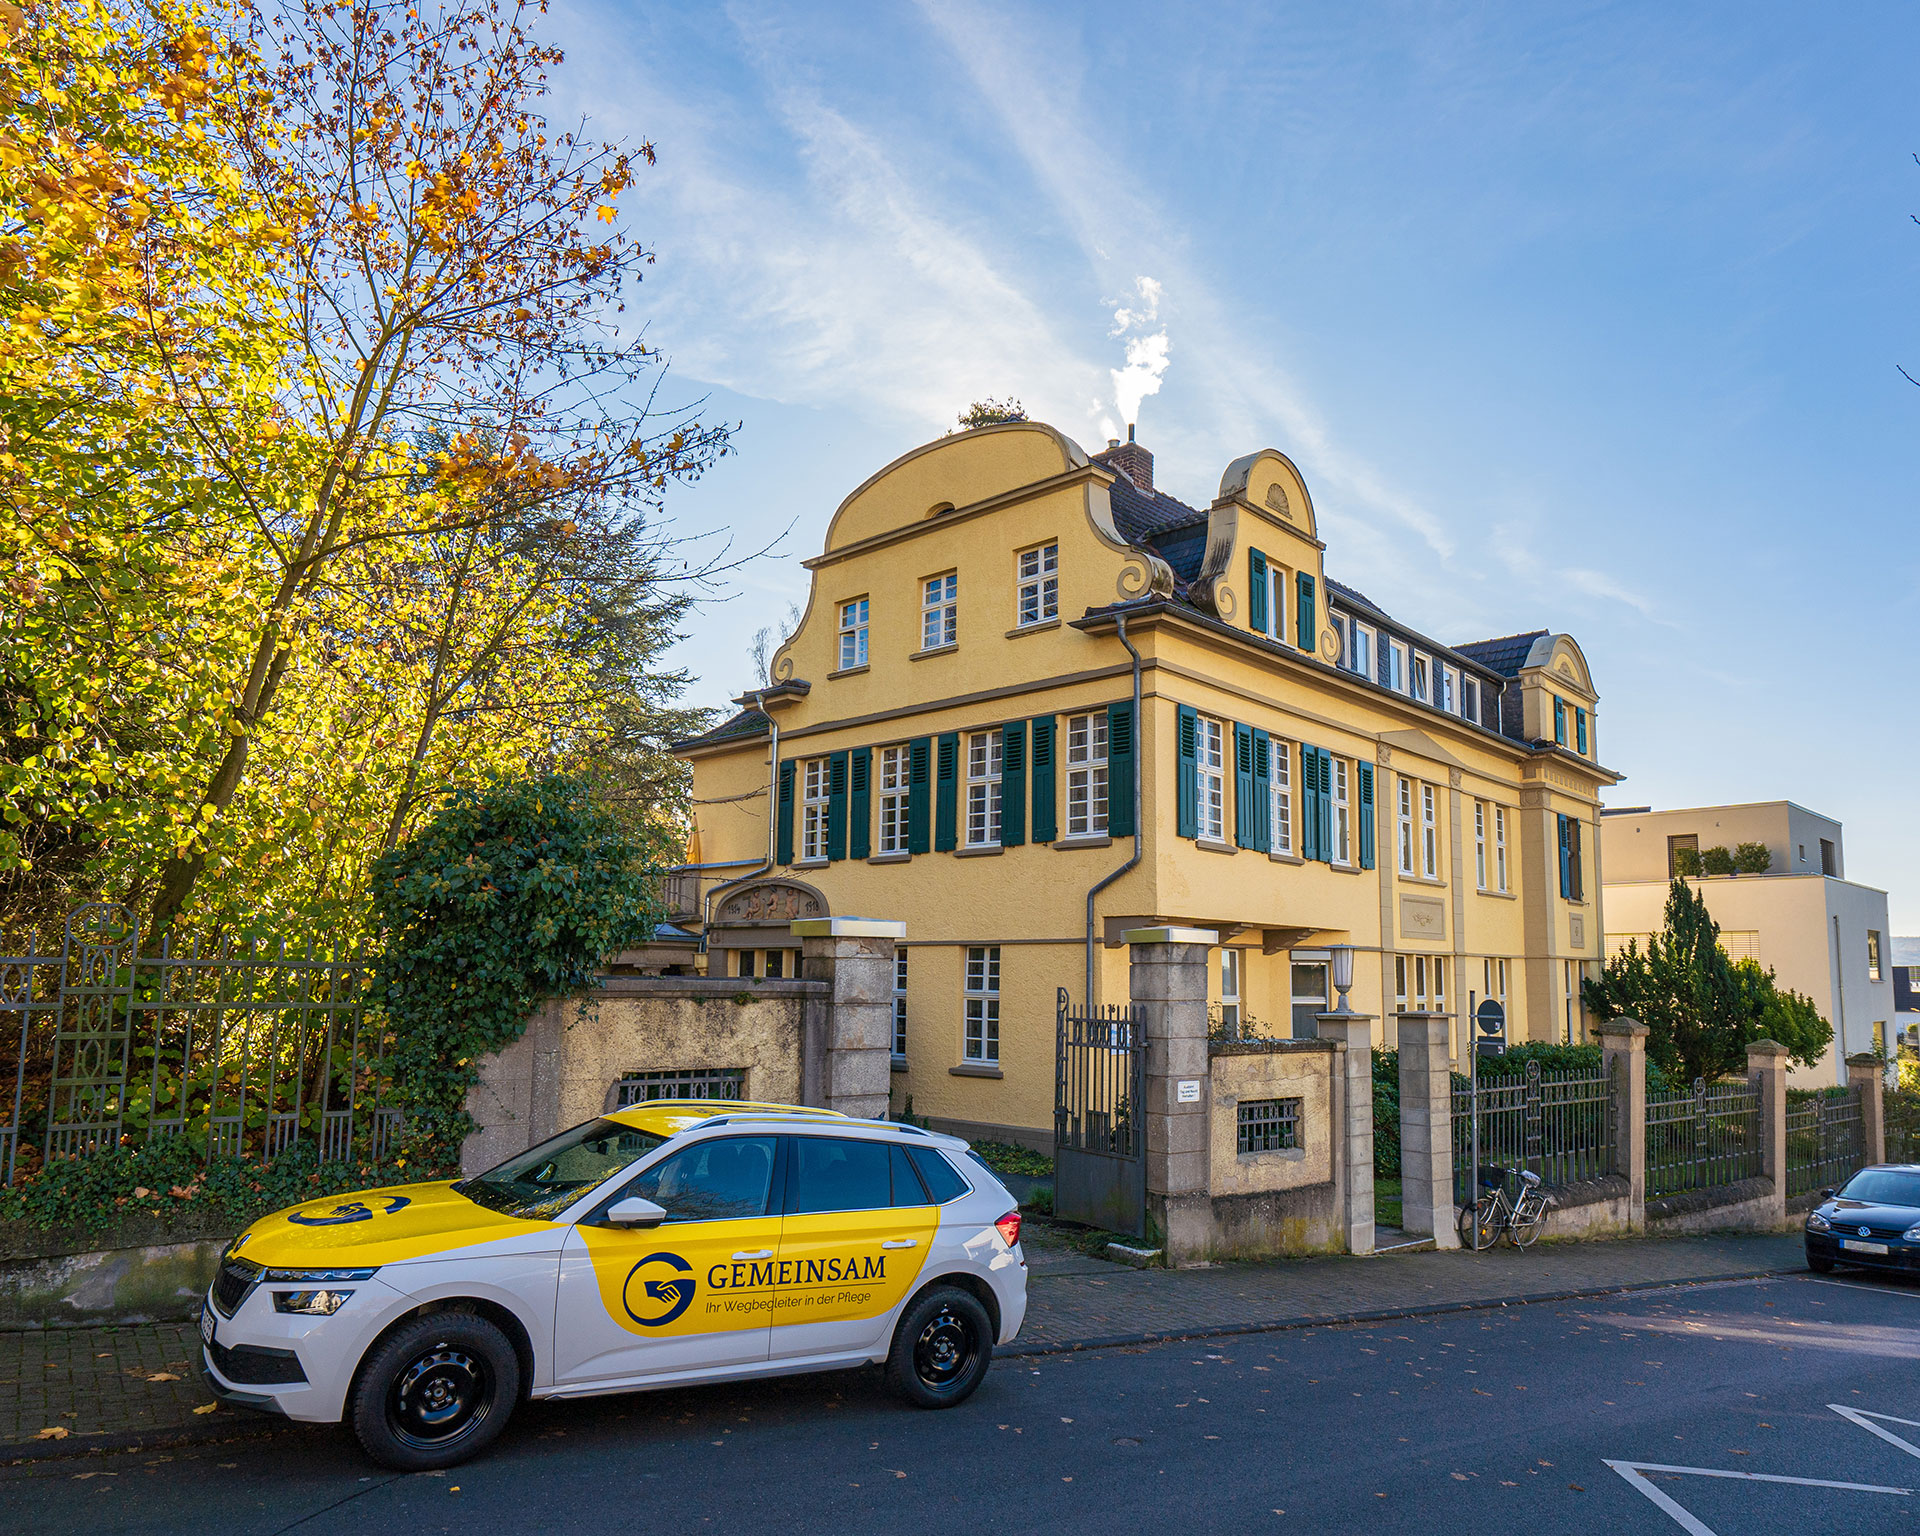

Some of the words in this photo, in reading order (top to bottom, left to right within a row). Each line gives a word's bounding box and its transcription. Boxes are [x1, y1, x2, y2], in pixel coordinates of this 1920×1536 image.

[707, 1255, 886, 1289] GEMEINSAM
[706, 1301, 721, 1313] Ihr
[724, 1296, 803, 1314] Wegbegleiter
[804, 1295, 814, 1306] in
[816, 1294, 835, 1305] der
[837, 1291, 871, 1304] Pflege
